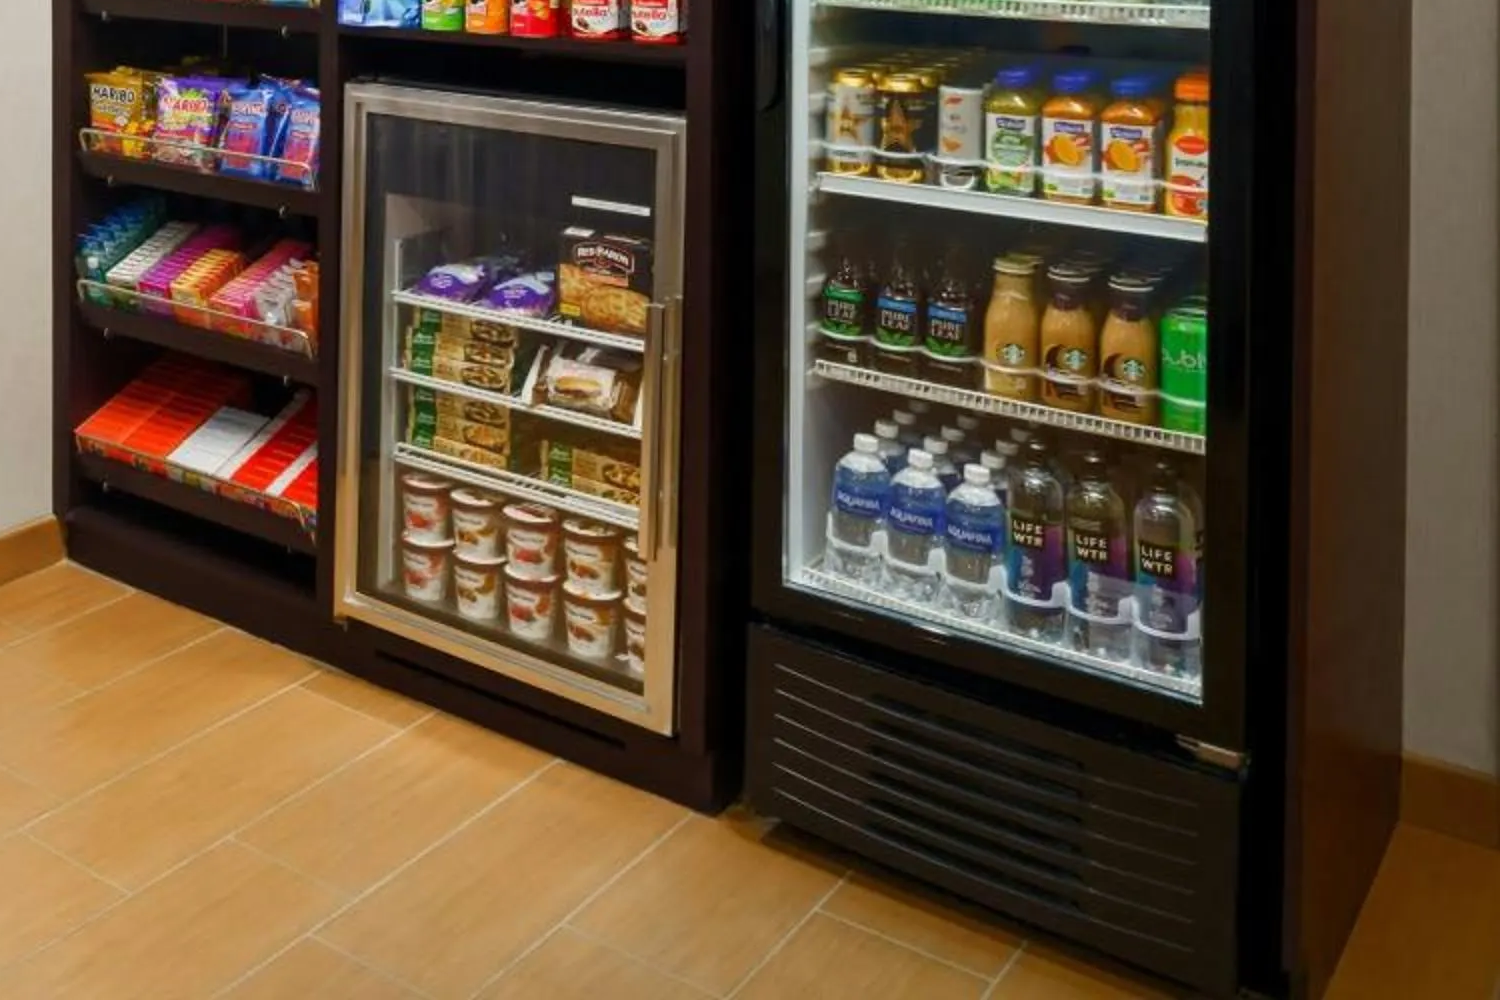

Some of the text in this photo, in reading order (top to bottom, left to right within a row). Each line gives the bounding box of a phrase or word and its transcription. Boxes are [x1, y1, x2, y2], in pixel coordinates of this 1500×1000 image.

[91, 85, 135, 104] HARIBO
[827, 307, 855, 319] LEAF
[881, 318, 909, 331] LEAF
[931, 327, 960, 341] LEAF
[836, 490, 881, 510] AQUAFINA
[890, 506, 934, 528] AQUAFINA
[947, 523, 993, 545] AQUAFINA
[1013, 519, 1044, 535] LIFE
[1013, 532, 1044, 548] WTR
[1075, 533, 1108, 550] LIFE
[1076, 545, 1108, 561] WTR
[1140, 545, 1173, 561] LIFE
[1141, 557, 1173, 575] WTR
